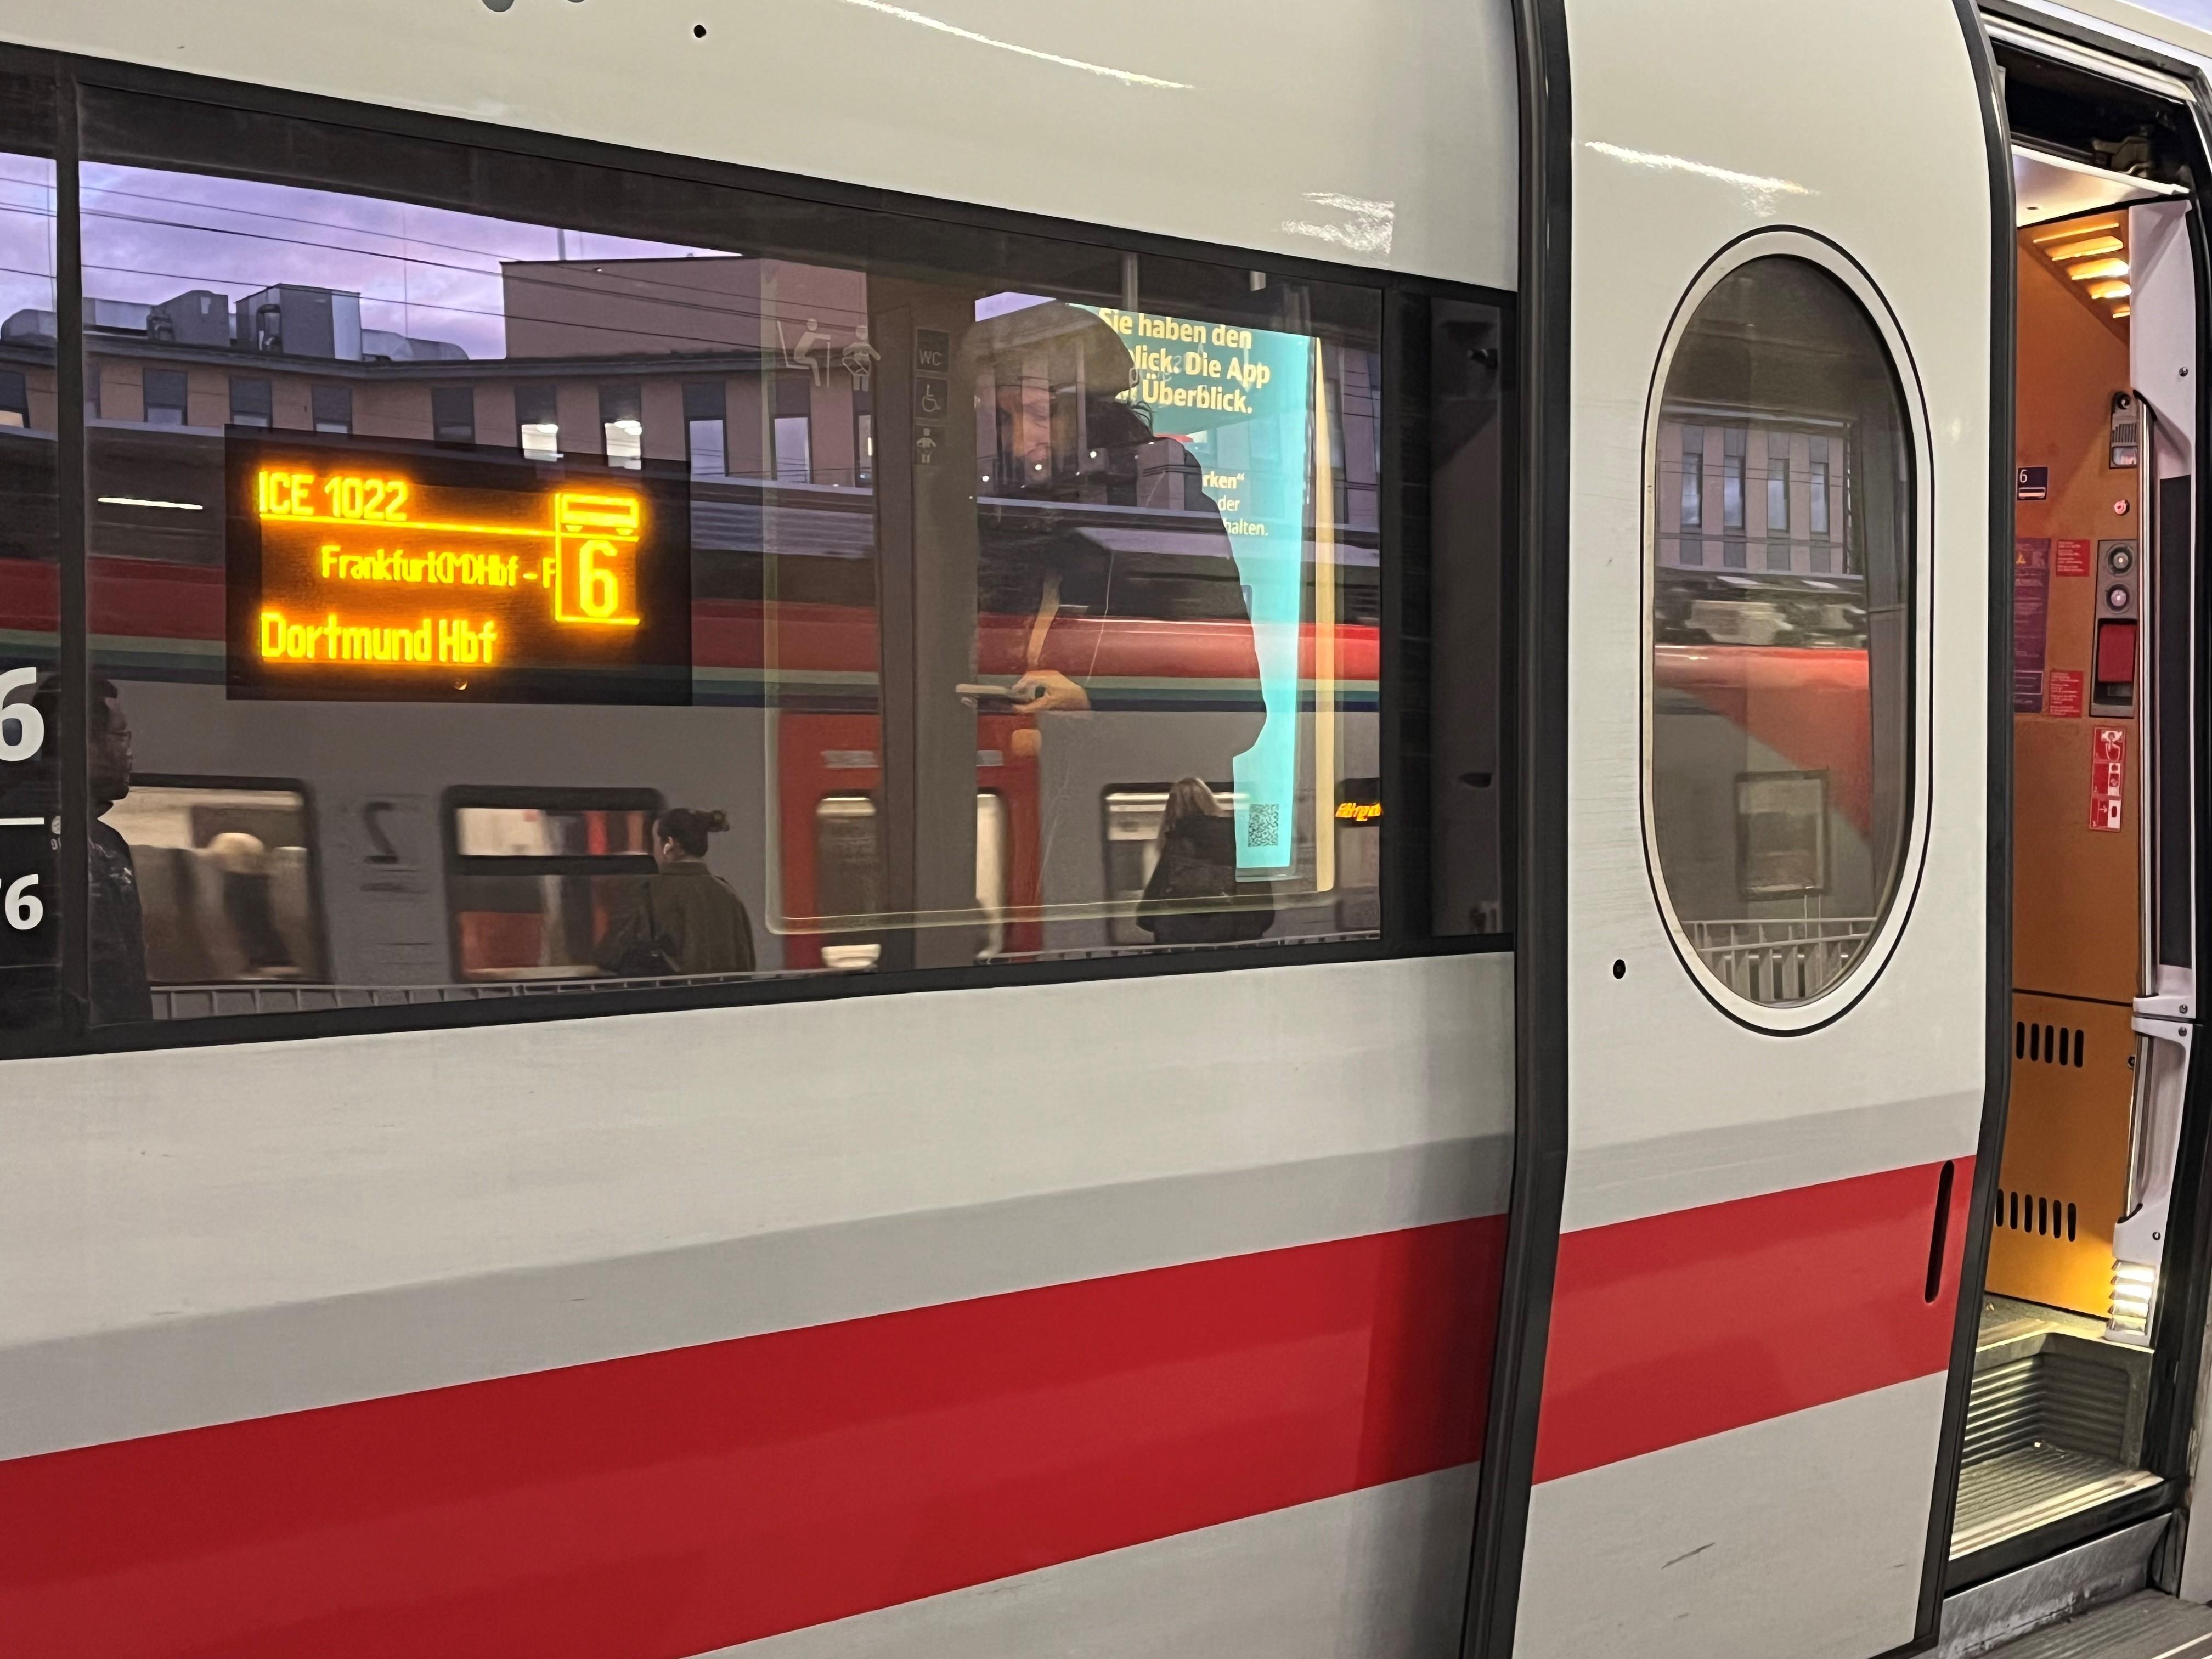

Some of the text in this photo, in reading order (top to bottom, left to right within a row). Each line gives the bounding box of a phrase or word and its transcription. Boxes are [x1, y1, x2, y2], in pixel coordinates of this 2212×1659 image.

[1099, 308, 1252, 349] Sie haben den
[919, 348, 943, 366] WC
[1185, 351, 1222, 377] Die
[1227, 357, 1271, 389] App
[1142, 373, 1253, 414] Überblick.
[259, 470, 408, 522] ICE 1022
[2019, 469, 2028, 483] 6
[1217, 495, 1240, 511] der
[579, 539, 618, 618] 6
[261, 611, 498, 664] Dortmund Hbf
[0, 667, 44, 761] 6
[0, 873, 43, 930] 6
